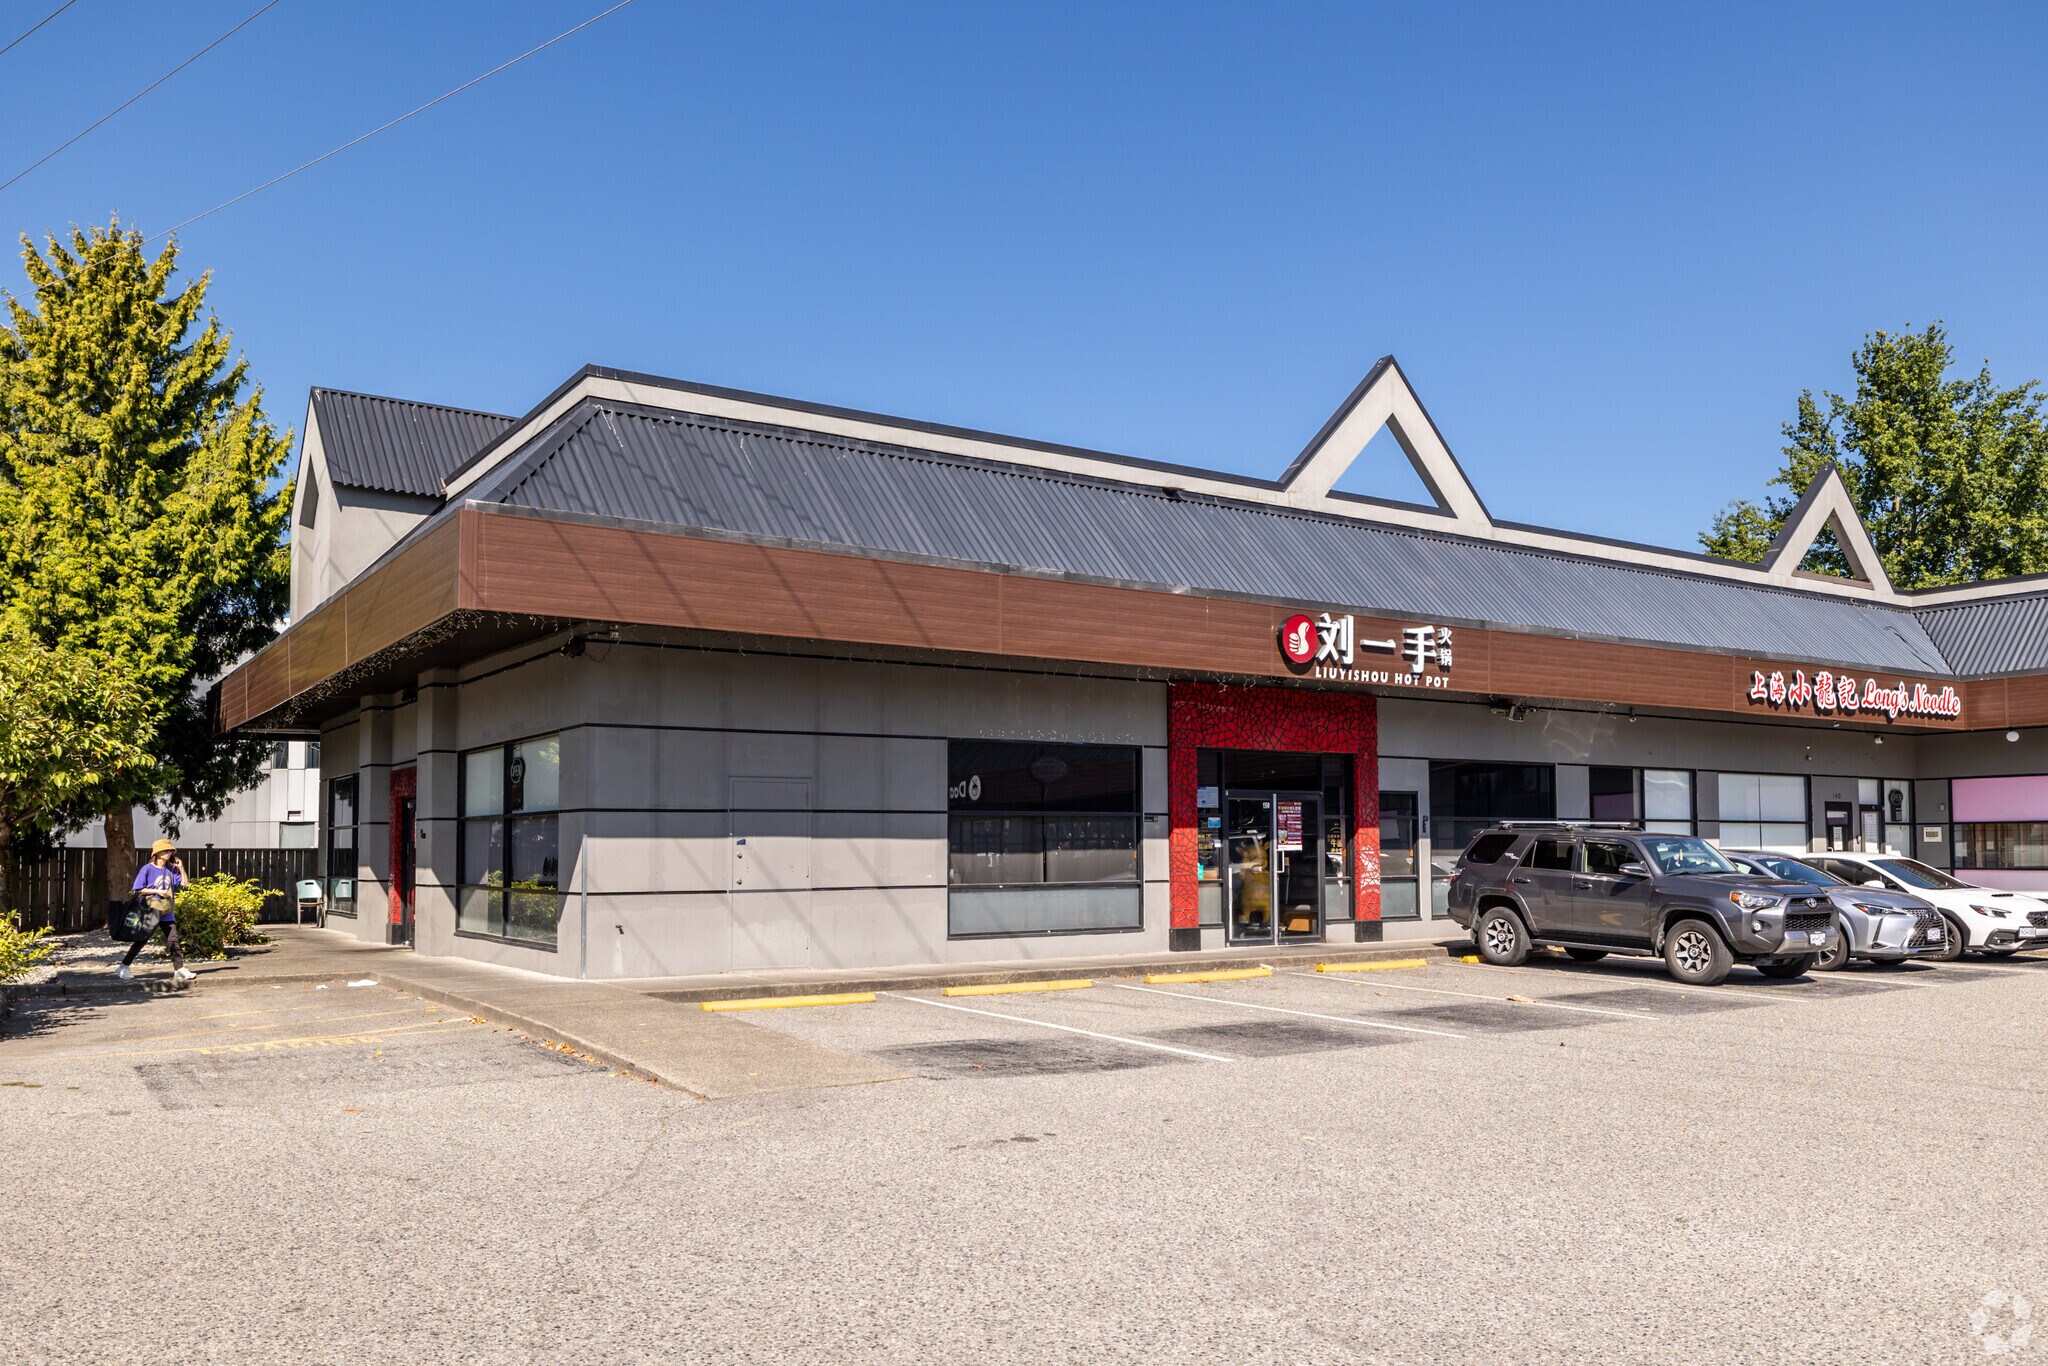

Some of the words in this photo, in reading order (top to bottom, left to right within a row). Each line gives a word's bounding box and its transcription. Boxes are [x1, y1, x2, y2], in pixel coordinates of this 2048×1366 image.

[1315, 612, 1437, 674] 刘一手
[1437, 627, 1453, 667] 火锅
[1315, 666, 1389, 683] LIUYISHOU
[1394, 673, 1420, 686] HOT
[1425, 675, 1449, 689] POT
[1861, 678, 1909, 718] Long's
[1909, 683, 1960, 716] Noodle
